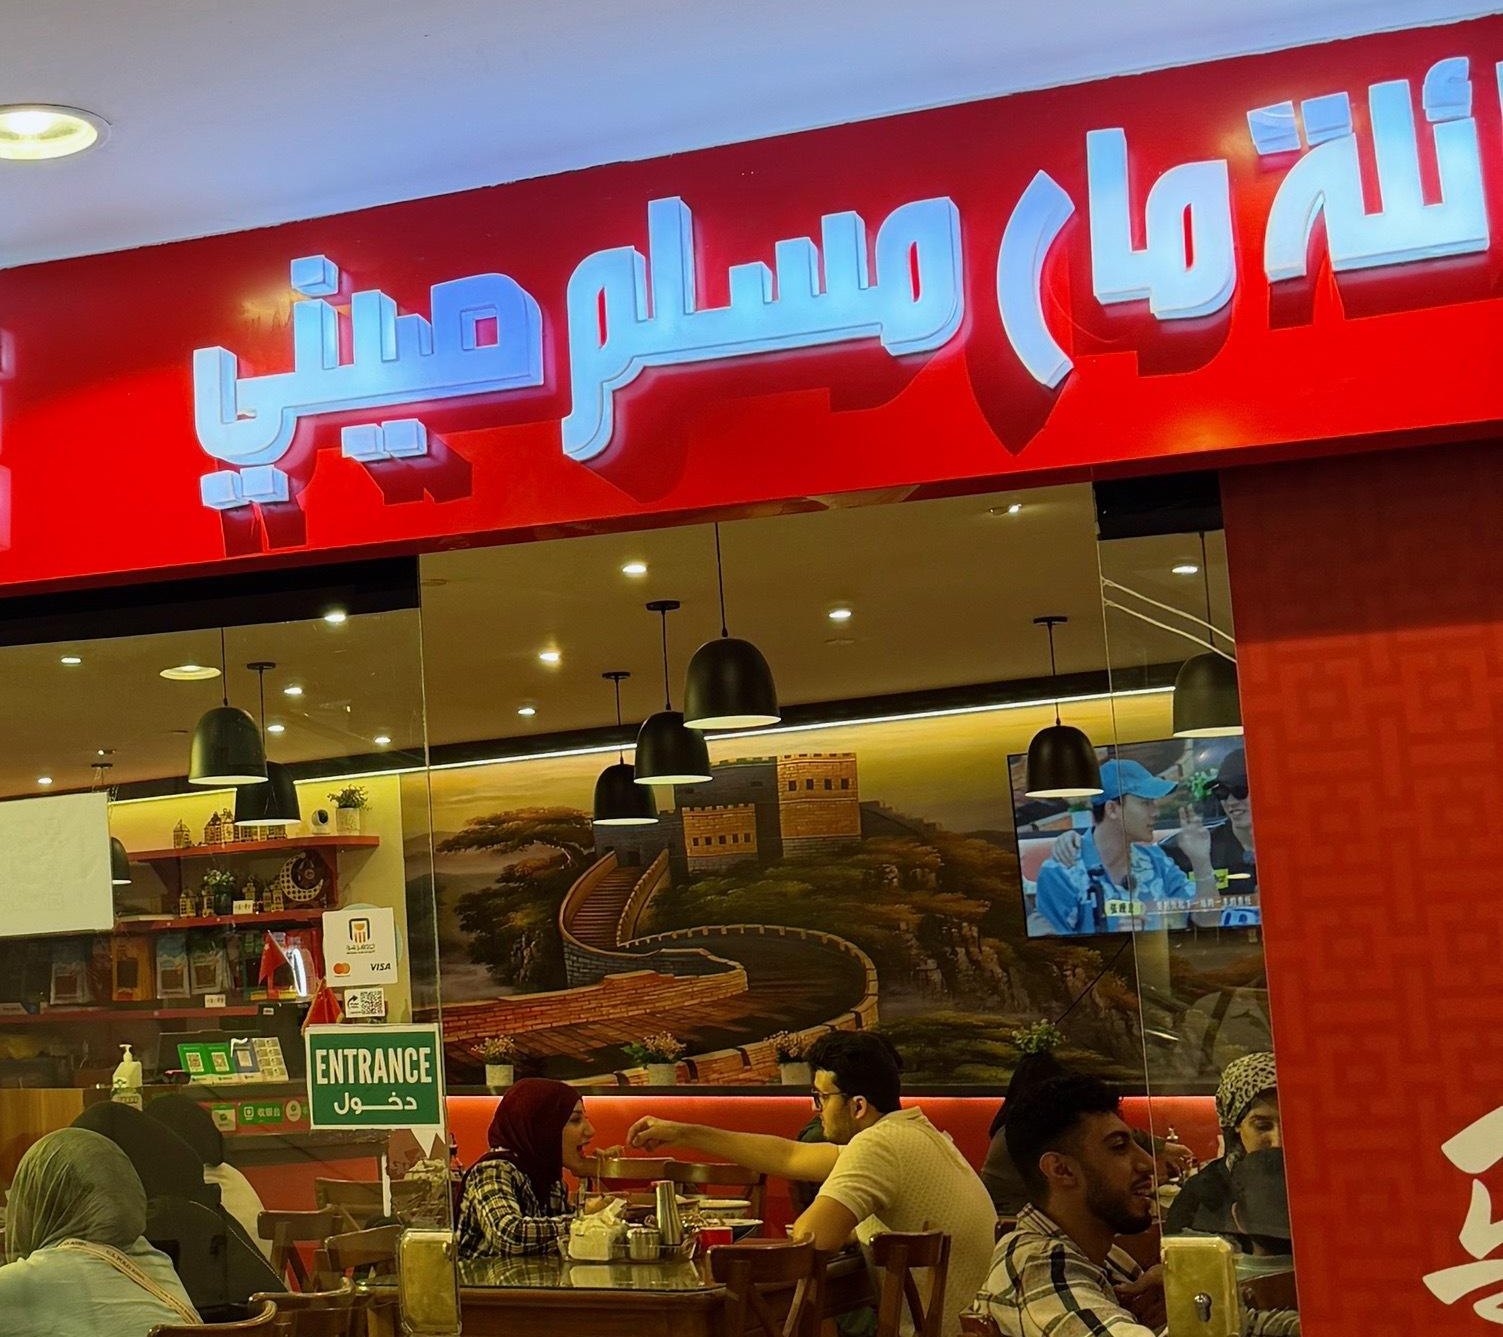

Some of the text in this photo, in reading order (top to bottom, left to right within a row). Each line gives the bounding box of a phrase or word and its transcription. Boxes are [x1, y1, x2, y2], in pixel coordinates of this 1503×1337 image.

[1246, 54, 1502, 282] ئلة
[192, 254, 545, 511] صيني
[562, 194, 966, 462] مسلم
[370, 962, 391, 971] VISA
[315, 1047, 432, 1084] ENTRANCE
[333, 1091, 417, 1115] دخول
